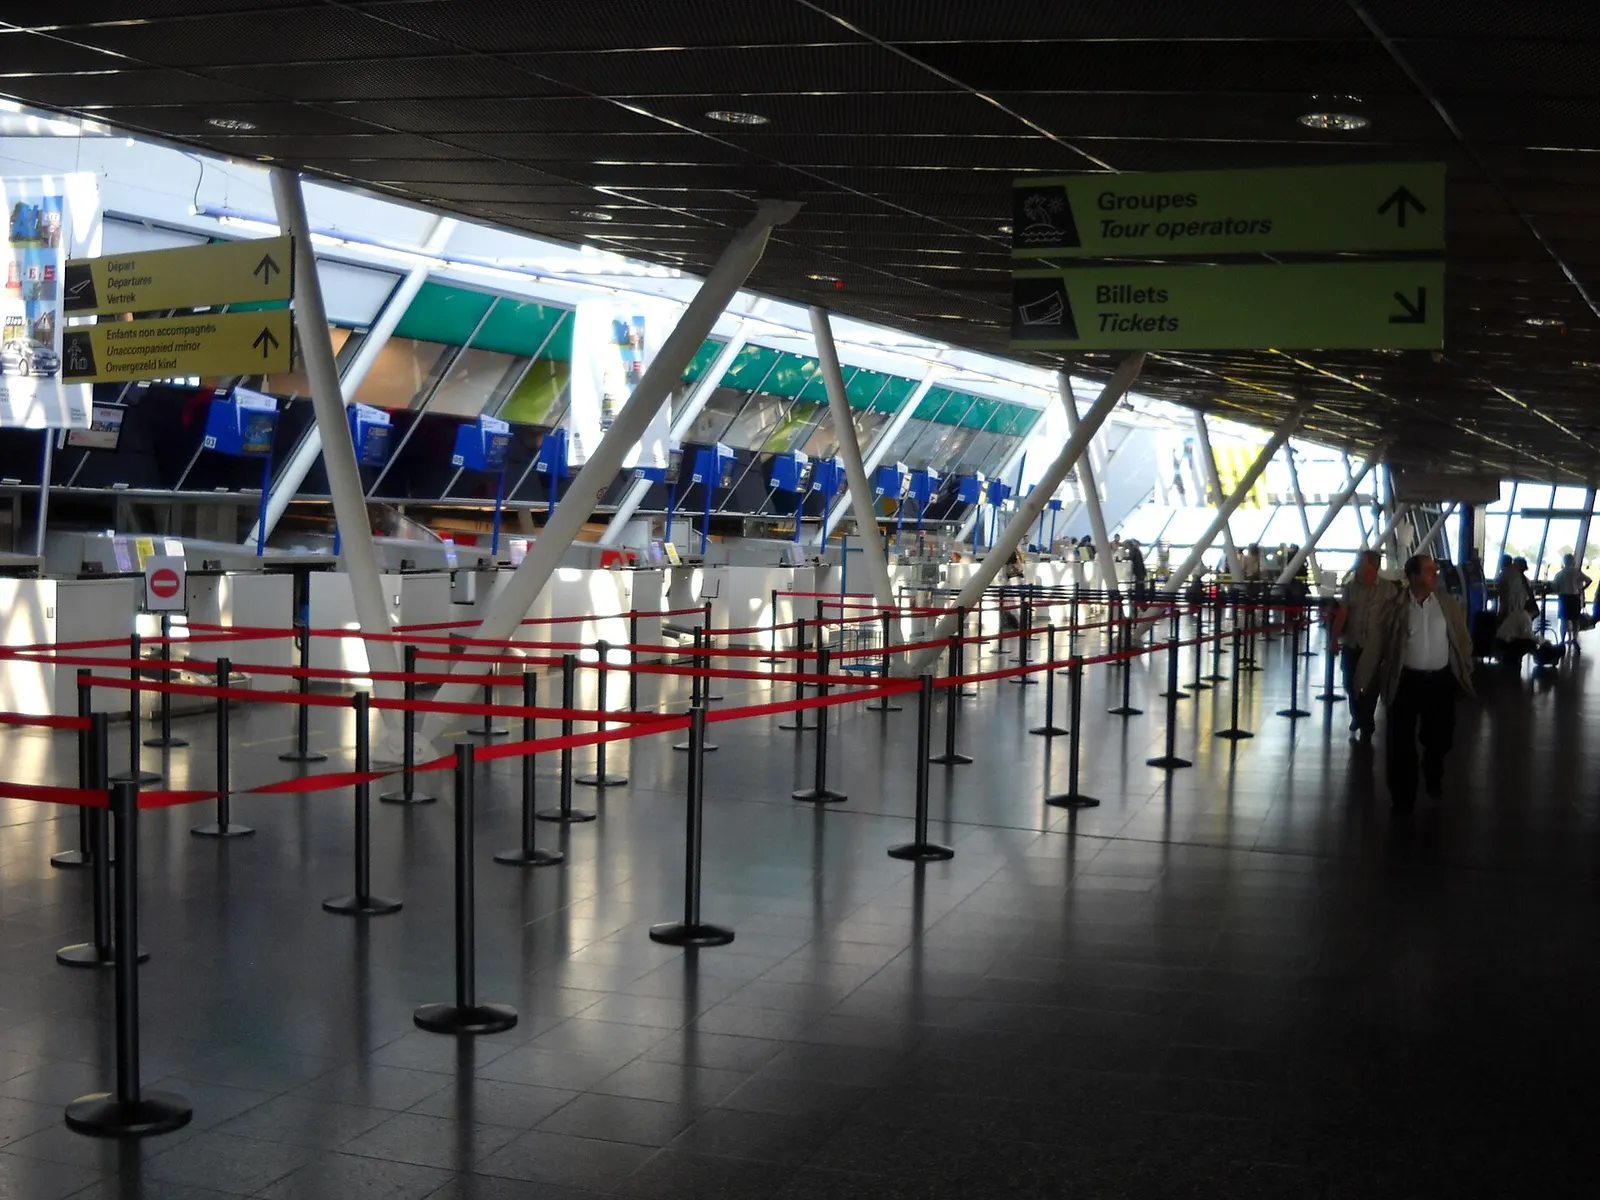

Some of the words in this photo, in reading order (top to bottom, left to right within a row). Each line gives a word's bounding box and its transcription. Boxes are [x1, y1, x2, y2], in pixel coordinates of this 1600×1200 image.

[1097, 191, 1197, 214] Groupes
[1100, 218, 1150, 239] Tour
[1155, 217, 1273, 241] operators
[107, 260, 135, 274] Départ
[107, 277, 152, 291] Departures
[106, 293, 136, 305] Vertrek
[1096, 284, 1168, 305] Billets
[106, 328, 137, 341] Enfants
[138, 328, 155, 338] non
[156, 322, 217, 339] accompagnés
[1098, 313, 1180, 333] Tickets
[106, 343, 174, 357] Unaccompanied
[174, 340, 201, 353] minor
[106, 357, 156, 374] Onvergezeld
[157, 357, 178, 370] kind
